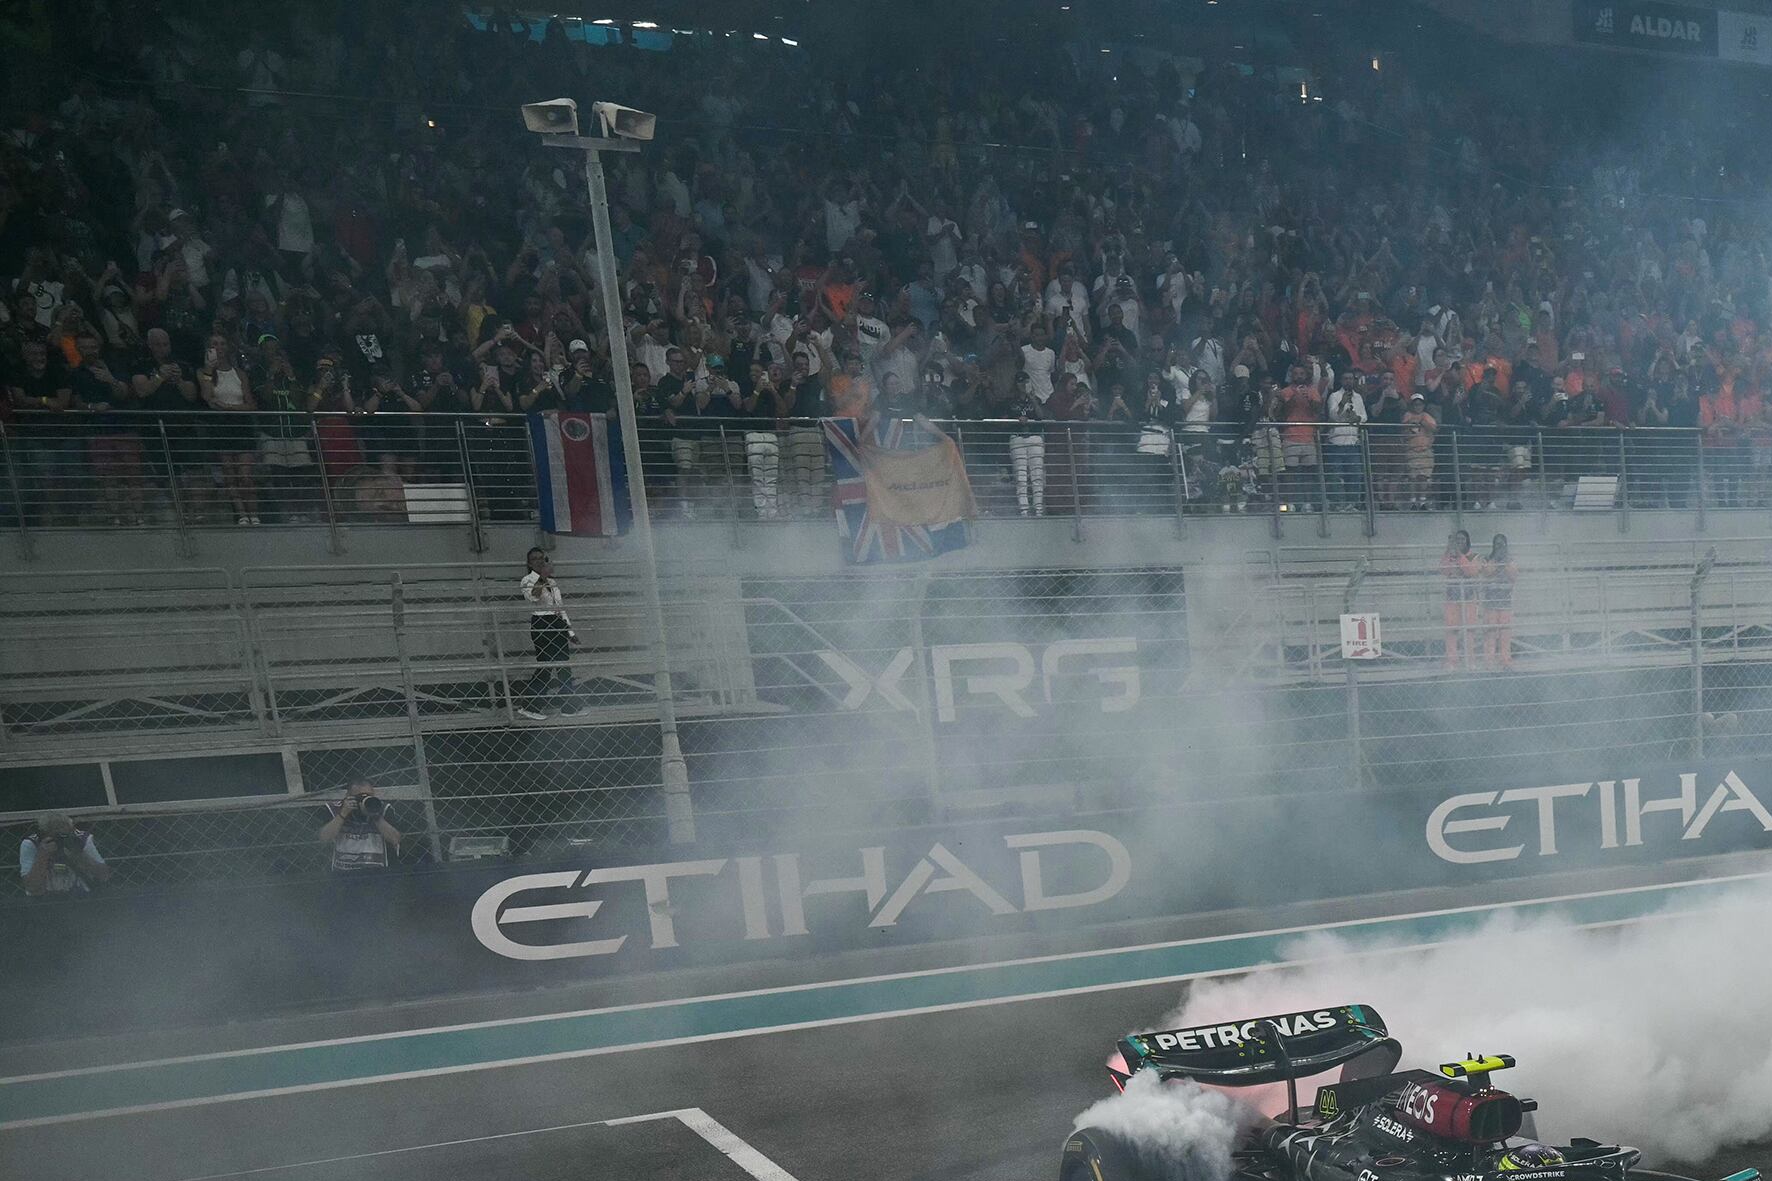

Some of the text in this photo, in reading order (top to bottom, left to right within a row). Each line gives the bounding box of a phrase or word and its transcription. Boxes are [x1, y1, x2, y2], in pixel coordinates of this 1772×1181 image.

[1630, 15, 1701, 42] ALDAR
[813, 638, 1141, 722] XRG
[471, 829, 1132, 961] ETIHAD
[1396, 1081, 1438, 1124] INEOS
[1377, 1117, 1408, 1140] SOLERA
[1510, 1171, 1566, 1181] CROWDSTRIKE
